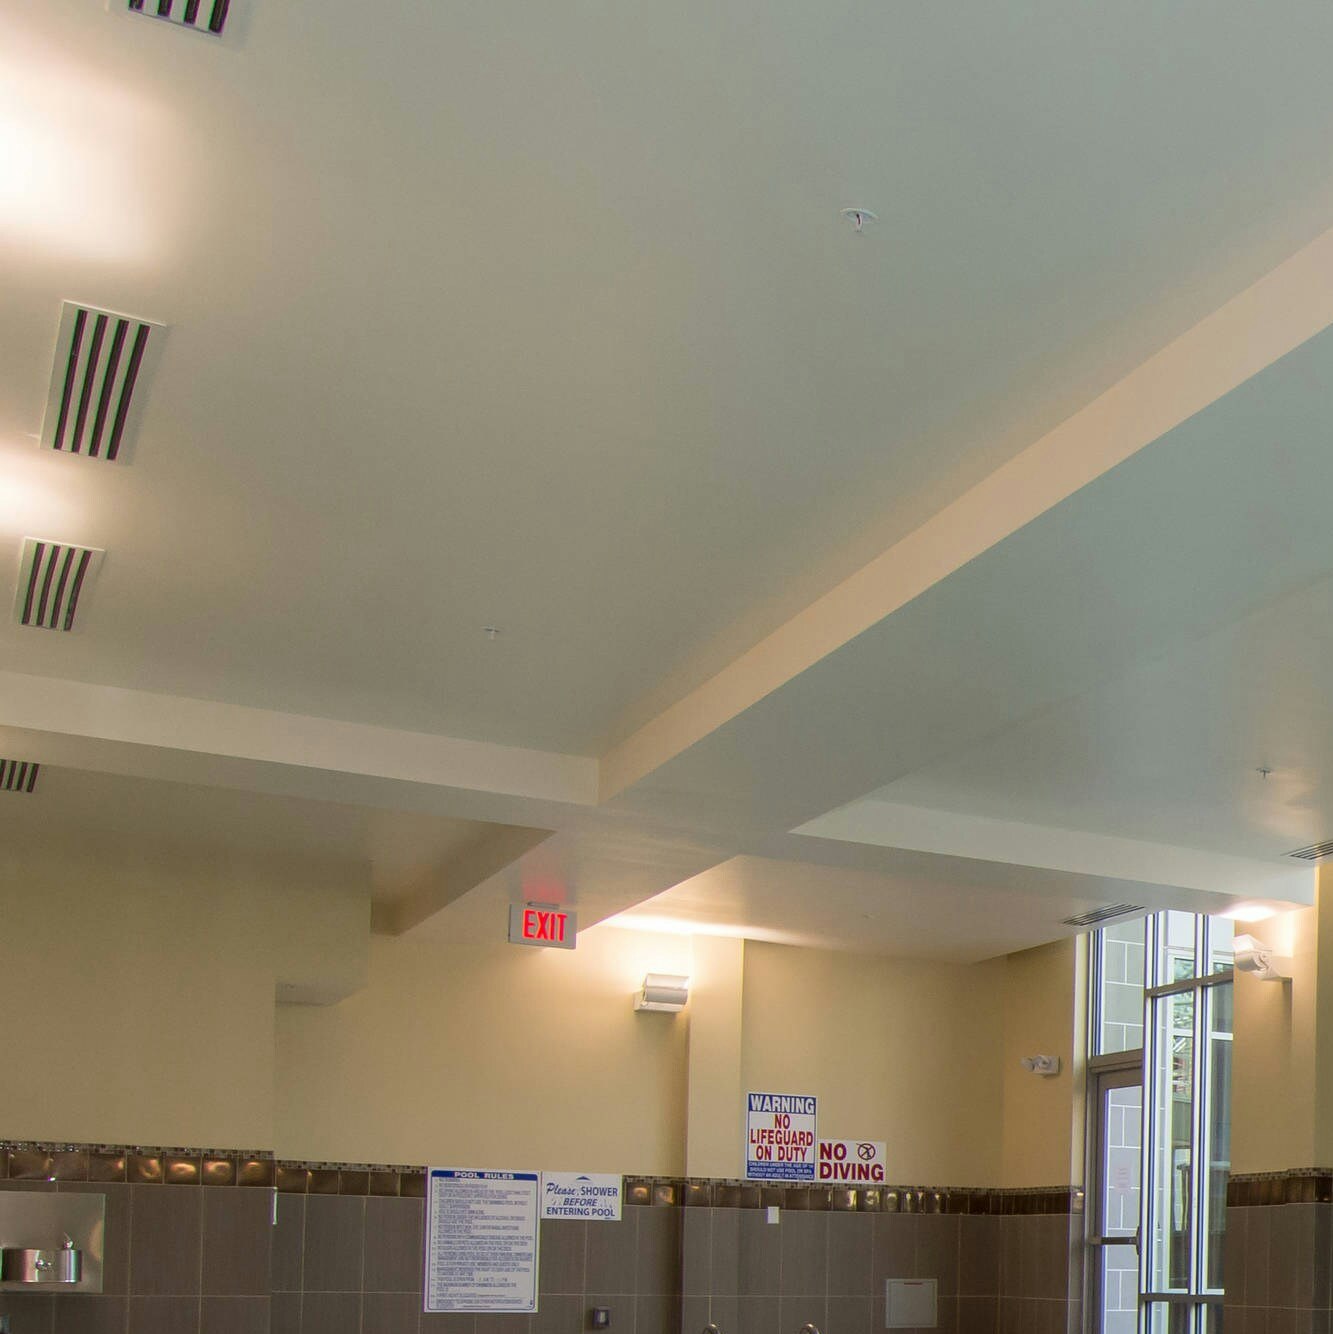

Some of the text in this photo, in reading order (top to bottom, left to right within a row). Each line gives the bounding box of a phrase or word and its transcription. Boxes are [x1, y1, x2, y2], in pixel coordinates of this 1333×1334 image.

[522, 909, 567, 942] EXIT
[750, 1094, 815, 1114] WARNING
[774, 1114, 791, 1129] NO
[750, 1129, 814, 1146] LIFEGUARD
[756, 1145, 807, 1161] ON DUTY
[819, 1143, 847, 1161] NO
[454, 1171, 514, 1180] POOL RULES
[819, 1161, 884, 1181] DIVING
[546, 1182, 618, 1197] Please SHOWER
[563, 1198, 598, 1207] BEFORE
[546, 1207, 615, 1217] ENTERING POOL
